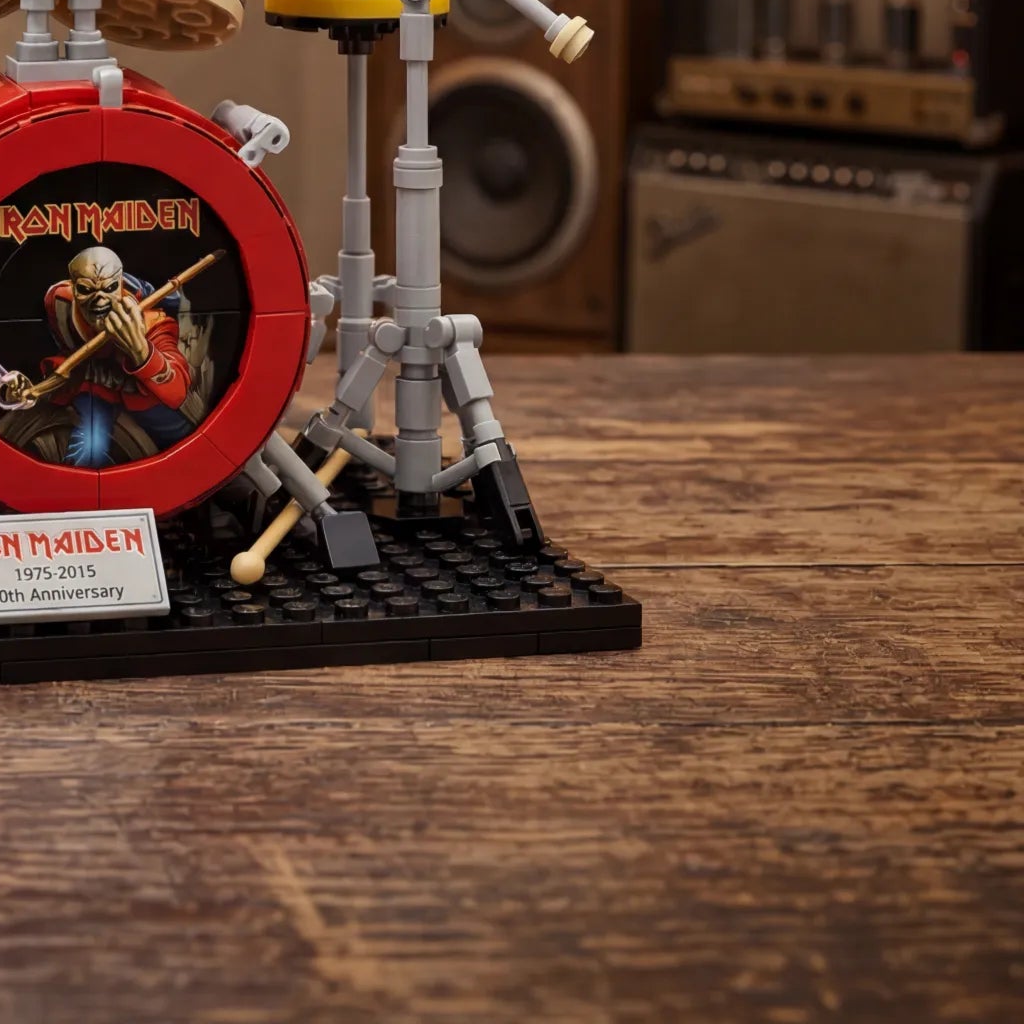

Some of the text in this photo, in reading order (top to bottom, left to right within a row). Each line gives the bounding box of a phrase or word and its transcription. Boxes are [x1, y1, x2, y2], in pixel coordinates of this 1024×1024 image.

[75, 198, 201, 243] MAIDEN
[27, 528, 145, 561] MAIDEN
[14, 564, 97, 582] 1975-2015
[30, 585, 124, 603] Anniversary
